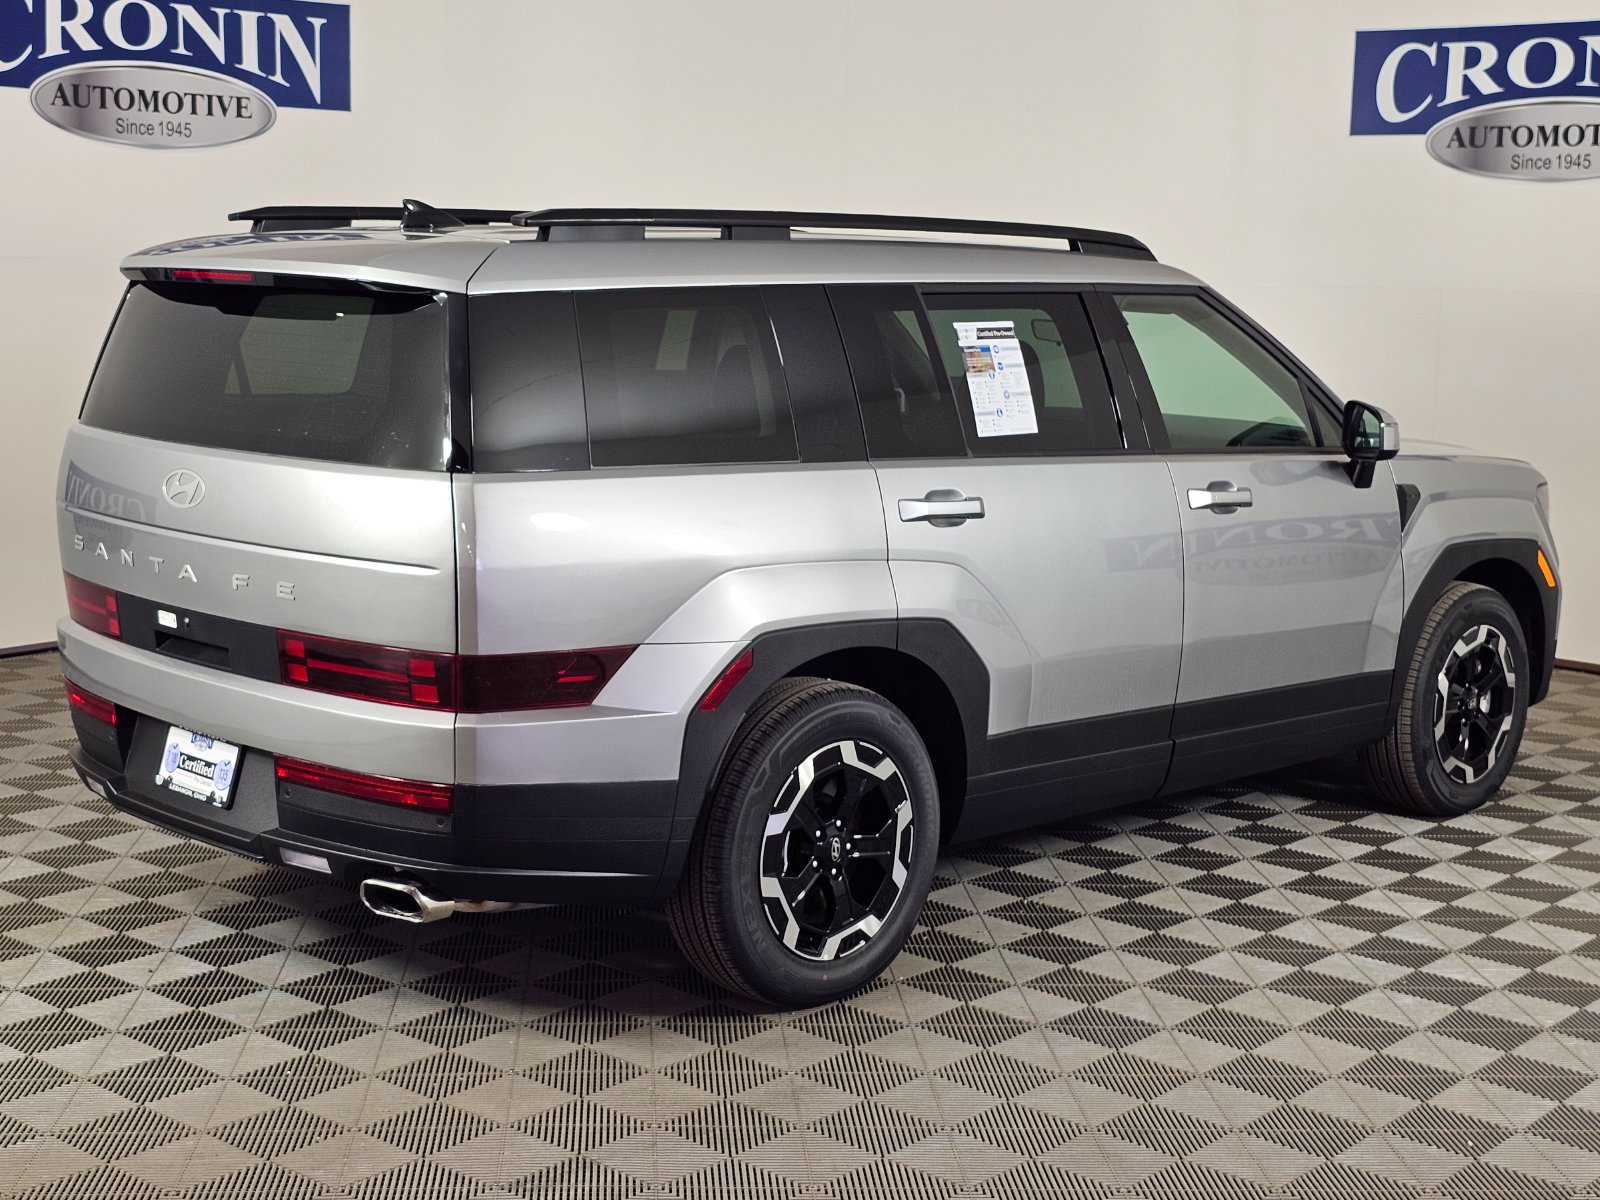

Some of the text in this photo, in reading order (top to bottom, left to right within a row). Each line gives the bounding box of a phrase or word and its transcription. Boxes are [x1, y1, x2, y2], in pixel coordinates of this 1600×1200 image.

[51, 83, 253, 119] AUTOMOTIVE
[115, 118, 193, 138] Since 1945
[1510, 152, 1592, 170] Since 1945
[74, 534, 296, 601] SANTA FE
[180, 754, 215, 777] Certified
